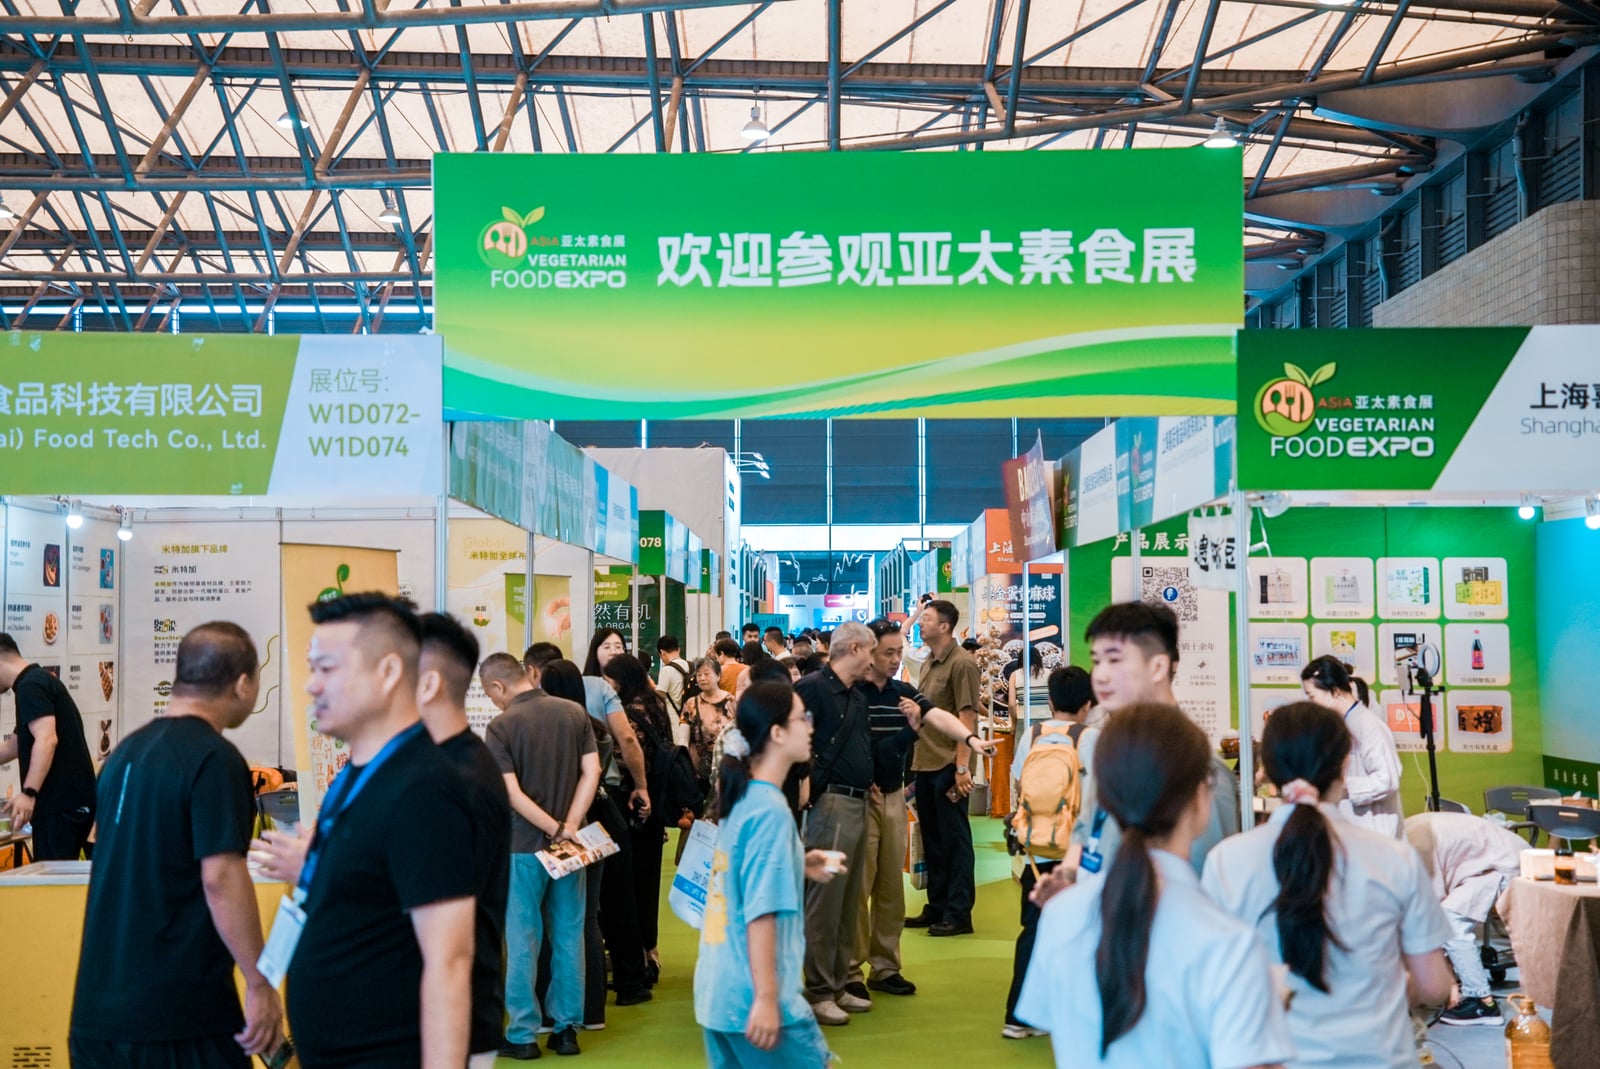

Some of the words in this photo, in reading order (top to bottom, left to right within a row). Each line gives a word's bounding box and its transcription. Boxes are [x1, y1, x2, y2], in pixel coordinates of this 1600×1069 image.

[561, 234, 626, 247] 亚太素食展
[527, 254, 627, 267] VEGETARIAN
[657, 227, 1197, 287] 欢迎参观亚太素食展
[1355, 395, 1434, 409] 亚太素食展
[309, 404, 421, 425] W1D072-
[1315, 417, 1435, 432] VEGETARIAN
[34, 429, 94, 449] Food
[103, 429, 158, 449] Tech
[168, 429, 212, 452] Co.,
[222, 429, 267, 449] Ltd.
[309, 436, 410, 458] W1D074
[639, 537, 662, 548] 078
[605, 622, 647, 631] ORGAC
